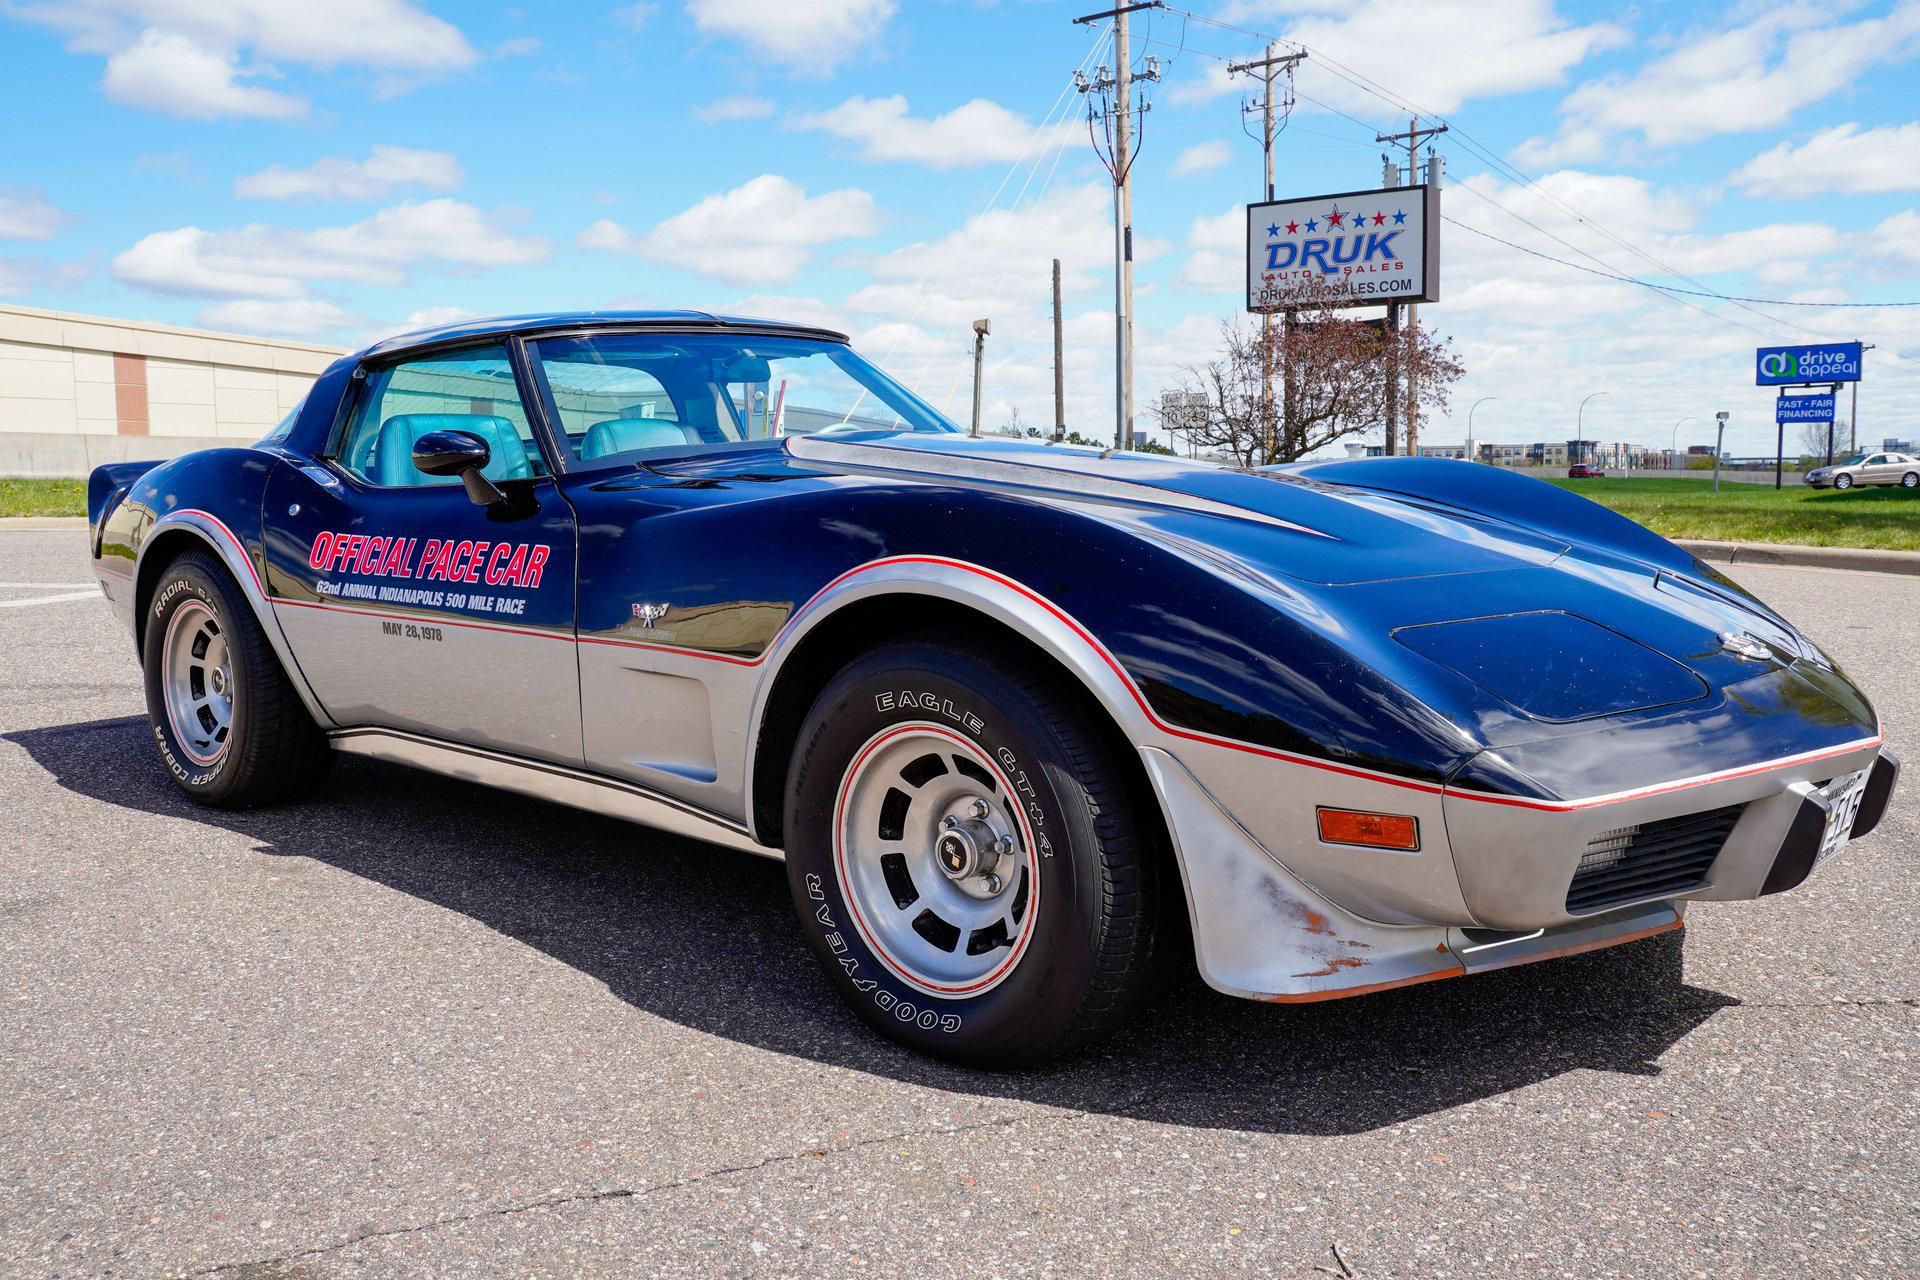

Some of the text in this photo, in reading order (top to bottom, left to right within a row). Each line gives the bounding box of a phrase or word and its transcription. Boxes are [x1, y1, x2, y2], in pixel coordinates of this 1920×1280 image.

[1265, 230, 1405, 275] DRUK
[1266, 261, 1404, 280] AUTO SALES
[1260, 278, 1412, 301] DRUKAUOSALES.COM
[1799, 361, 1857, 377] appeal
[1800, 351, 1846, 365] drive
[1778, 399, 1833, 409] FAST FAIR
[1778, 409, 1833, 419] FINANCING
[309, 531, 551, 588] OFFICIAL PACE CAR
[154, 580, 193, 618] RADIAL
[316, 580, 526, 615] 62nd ANNUAL INDIANAPOLIS 500 MILE RACE
[382, 621, 402, 636] MAY
[154, 725, 233, 785] COOPER COBRA
[875, 690, 1054, 858] EAGLE GT+4
[805, 873, 962, 1033] GOODYEAR
